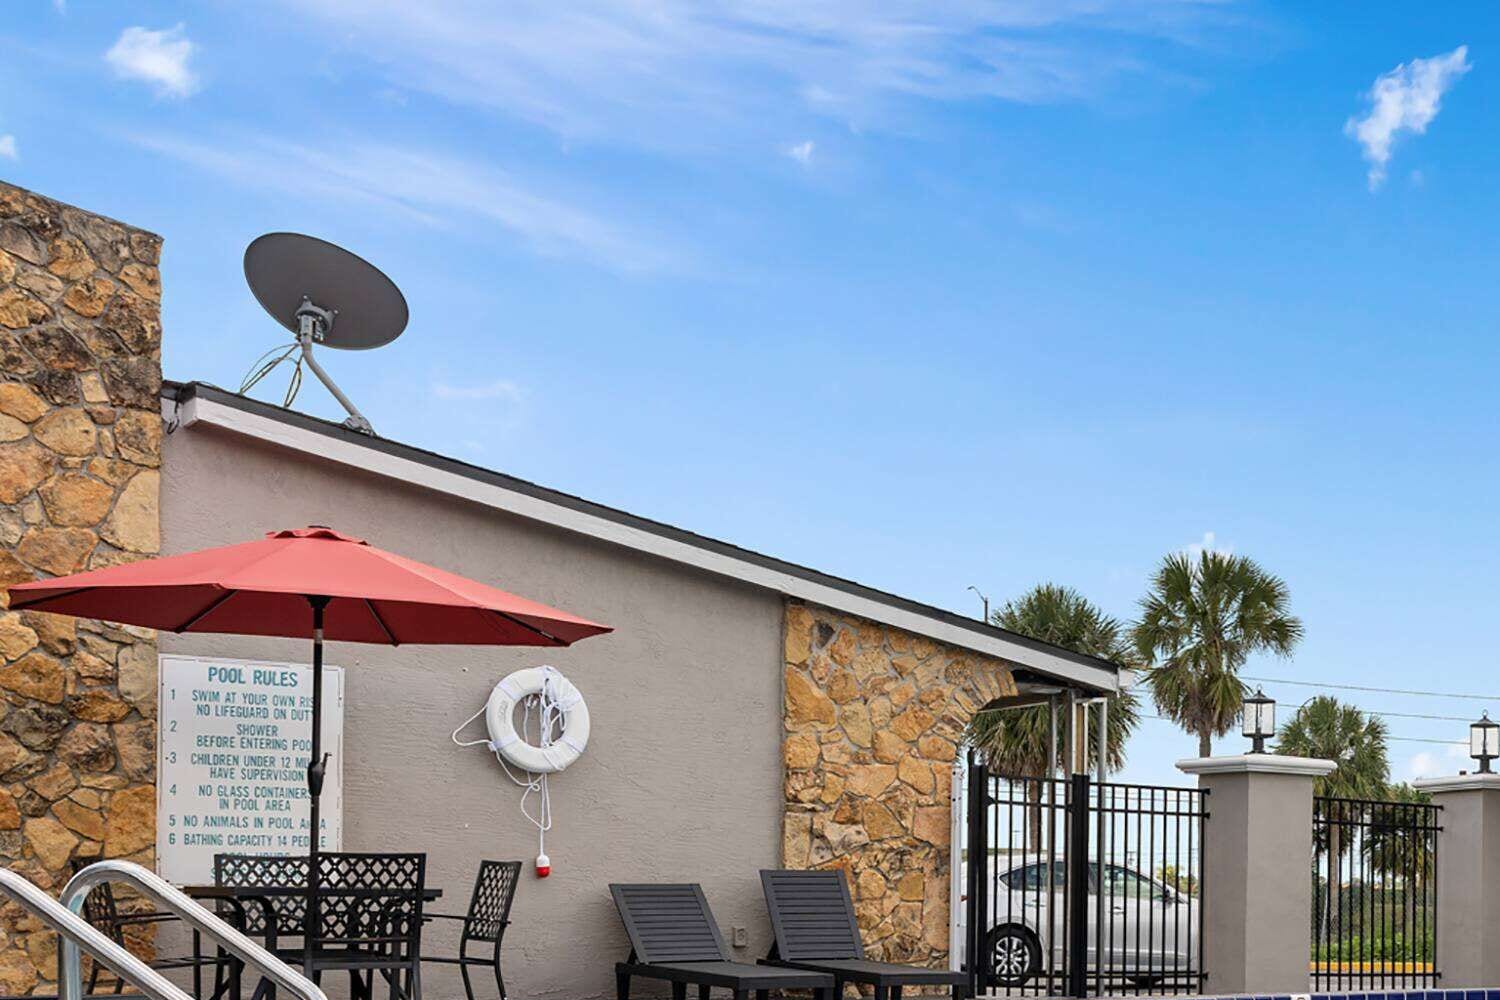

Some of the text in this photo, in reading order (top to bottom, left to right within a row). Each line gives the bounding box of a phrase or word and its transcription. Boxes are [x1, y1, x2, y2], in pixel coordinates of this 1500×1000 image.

[208, 667, 298, 687] POOL RULES
[171, 689, 314, 708] 1 SWIM AT YOUR OWN RIS
[196, 704, 211, 716] NO
[215, 705, 269, 719] LIFEGUARD
[273, 708, 287, 720] ON
[170, 720, 278, 736] 2 SHOWER
[196, 735, 312, 752] BEFORE ENTERING POO
[169, 752, 177, 764] 3
[191, 753, 240, 766] CHILDREN
[243, 755, 276, 767] UNDER
[281, 757, 291, 769] 12
[210, 767, 305, 782] HAVE SUPERVISION
[169, 784, 177, 796] 4
[198, 785, 213, 797] NO
[217, 785, 249, 798] GLASS
[219, 799, 291, 811] IN POOL AREA
[169, 815, 326, 830] 5 NO ANIMALS IN POOL ARA
[169, 833, 326, 848] 6 BATHING CAPACITY 14 PEOE
